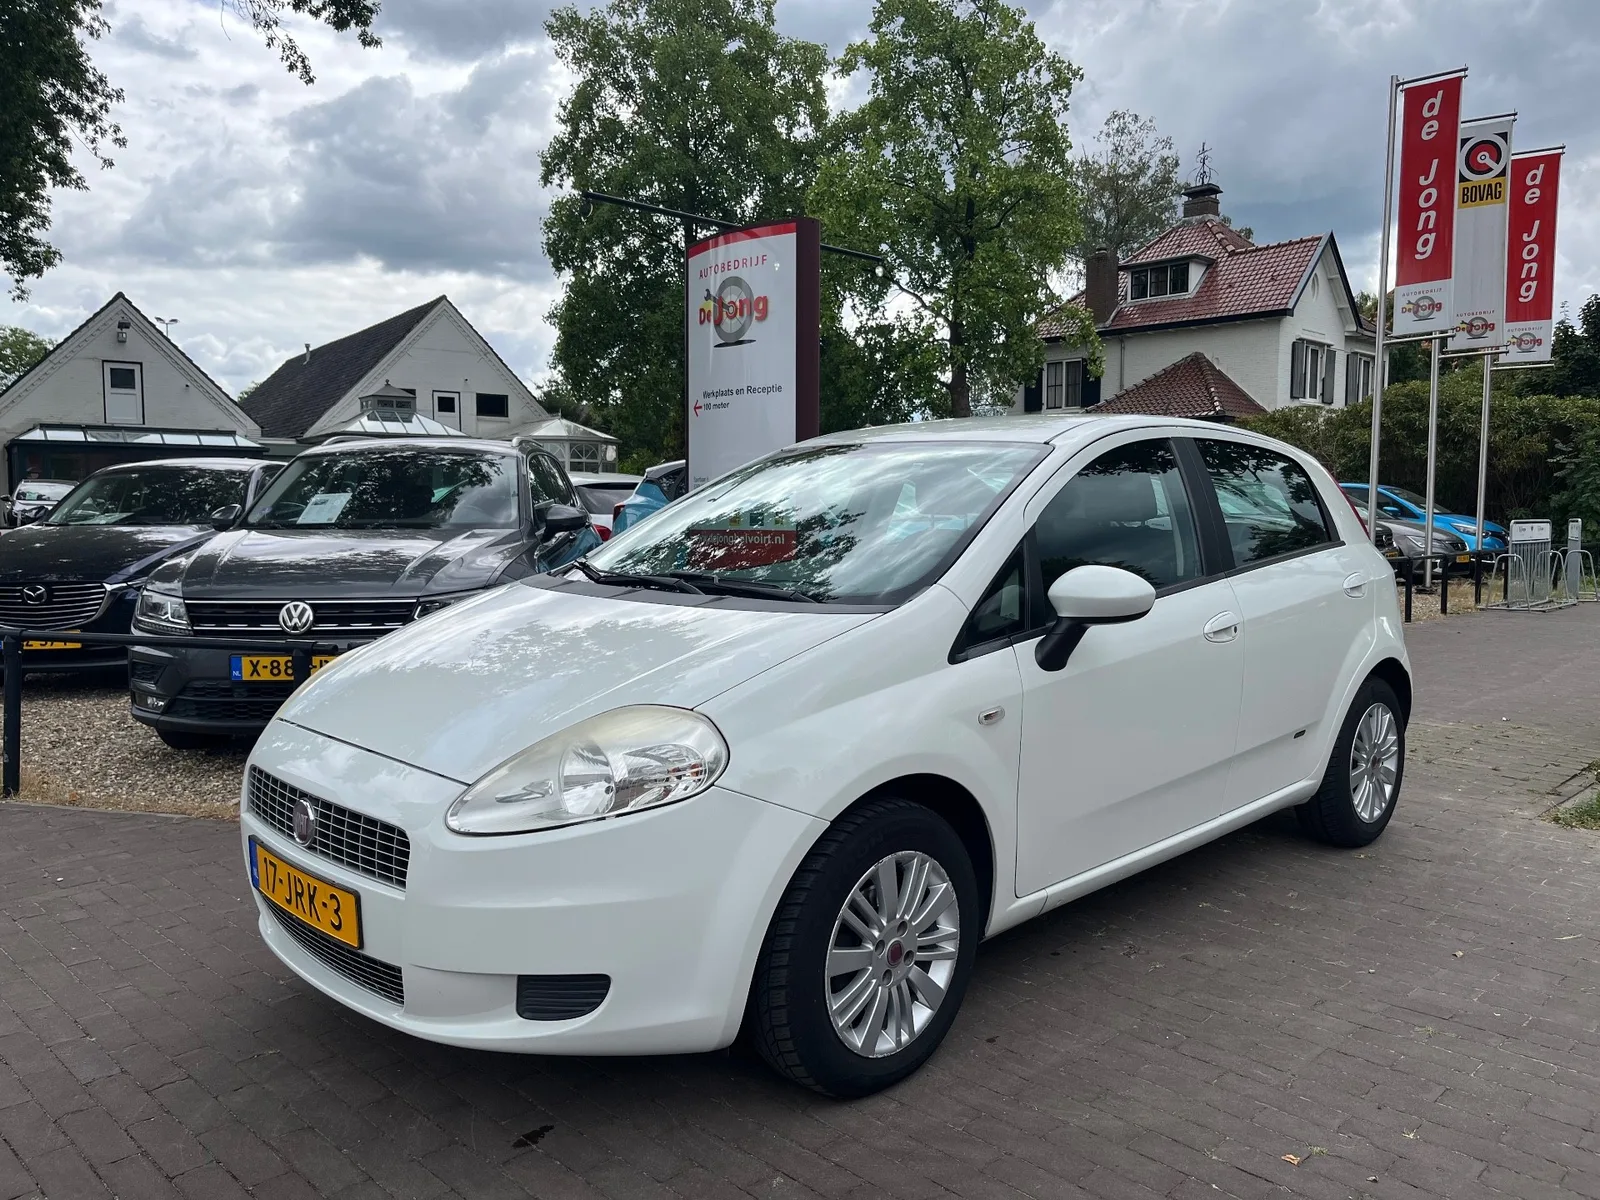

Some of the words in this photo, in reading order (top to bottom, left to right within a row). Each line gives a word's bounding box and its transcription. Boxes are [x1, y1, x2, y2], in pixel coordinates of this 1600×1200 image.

[1420, 89, 1444, 141] de
[1461, 181, 1503, 204] BOVAG
[1524, 163, 1545, 205] de
[1414, 158, 1439, 260] Jong
[698, 254, 768, 280] AUTOBEDRIJF
[1518, 219, 1540, 303] Jong
[1401, 287, 1443, 297] AUTOBEDRIJF
[1455, 310, 1496, 318] AUTOBEDRIJF
[702, 388, 734, 400] Werkplaats
[735, 387, 745, 396] en
[746, 383, 783, 396] Receptie
[703, 402, 712, 411] 100
[712, 401, 730, 410] meter
[263, 856, 343, 932] 17-JRK-3
